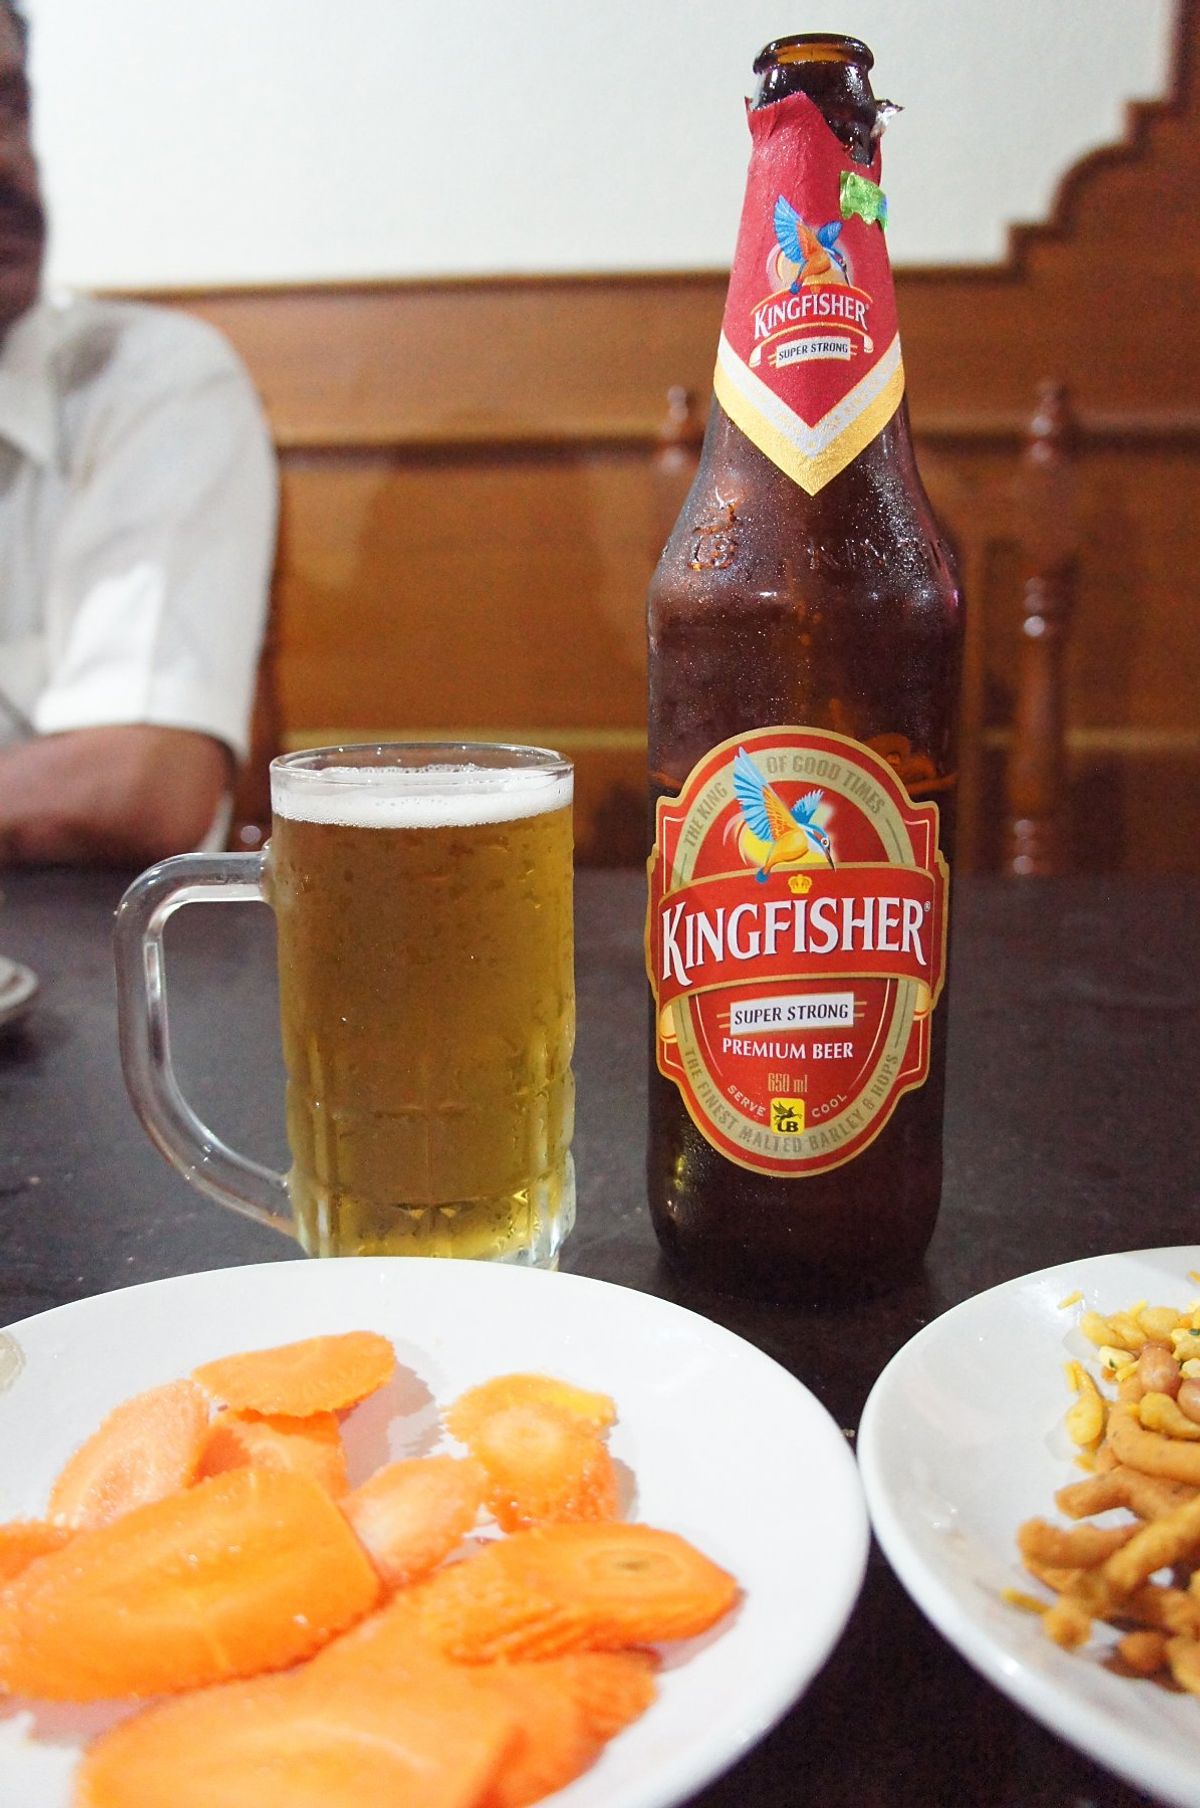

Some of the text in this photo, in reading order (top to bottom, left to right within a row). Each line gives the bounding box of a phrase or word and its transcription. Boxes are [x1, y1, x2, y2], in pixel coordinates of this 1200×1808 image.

[754, 293, 868, 340] KINGFISHER
[778, 342, 848, 361] SUPER STRONG
[684, 755, 884, 848] THE KING OF GOOD TIMES
[661, 896, 927, 987] KINGFISHER
[734, 1003, 849, 1025] SUPER STRONG
[722, 1037, 853, 1060] PREMIUM BEER
[685, 1049, 701, 1078] THE
[698, 1082, 740, 1130] FINEST
[740, 1127, 806, 1152] MALTED
[808, 1110, 866, 1150] BARLEY
[871, 1054, 898, 1097] HOPS
[726, 1084, 847, 1118] SERVE COOL
